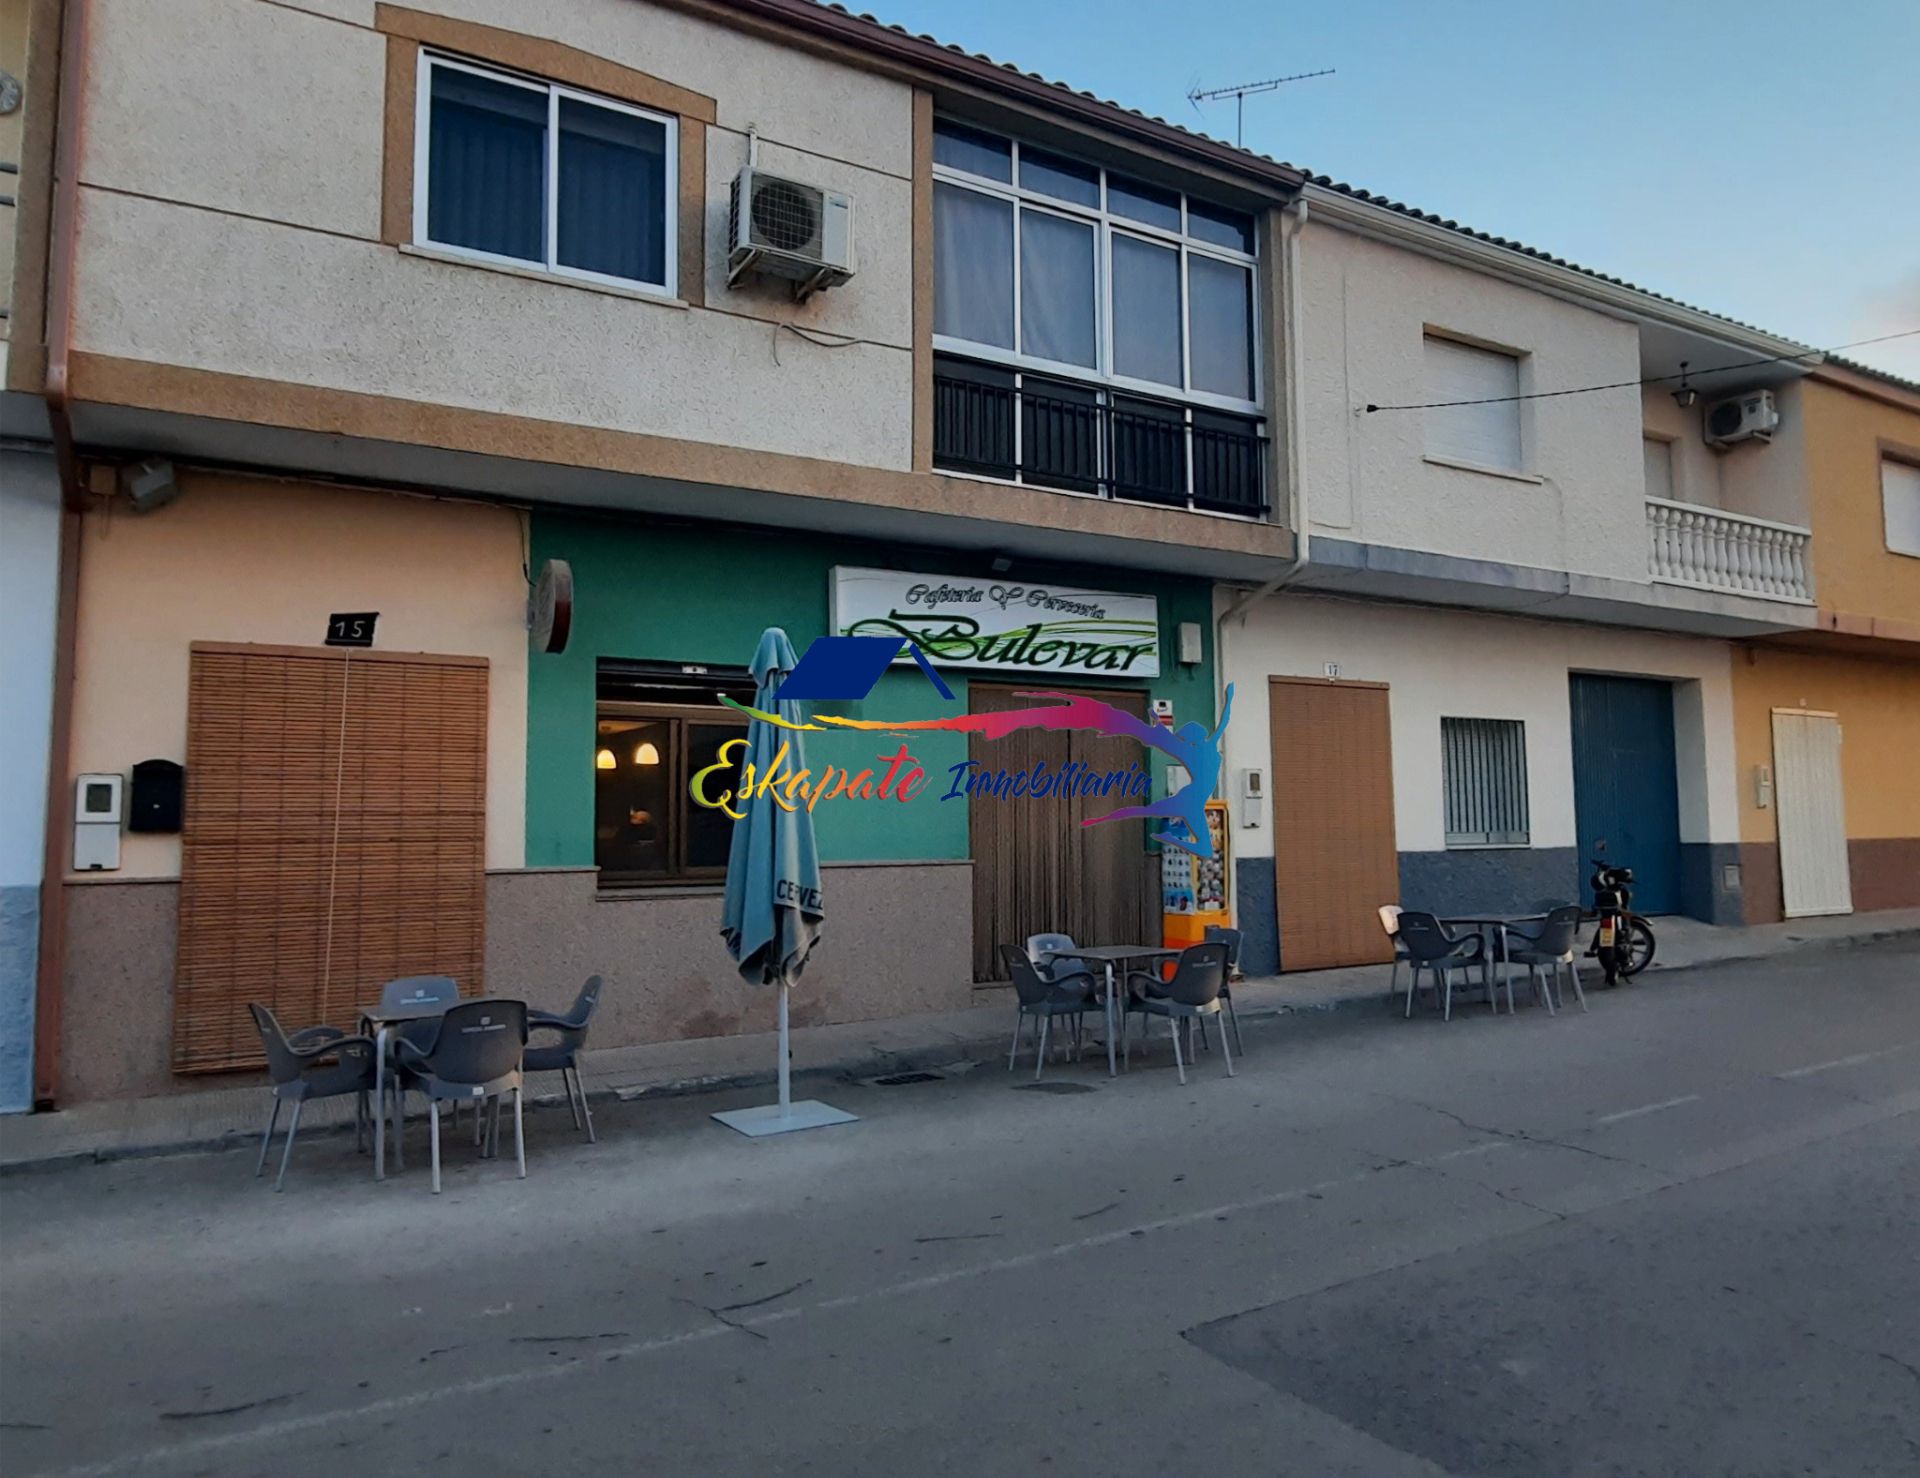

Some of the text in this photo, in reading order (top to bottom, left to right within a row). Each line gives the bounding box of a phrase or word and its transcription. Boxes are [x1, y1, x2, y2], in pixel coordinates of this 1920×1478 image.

[335, 620, 366, 638] 15
[849, 609, 1156, 671] Bulevar
[1328, 664, 1338, 676] 17
